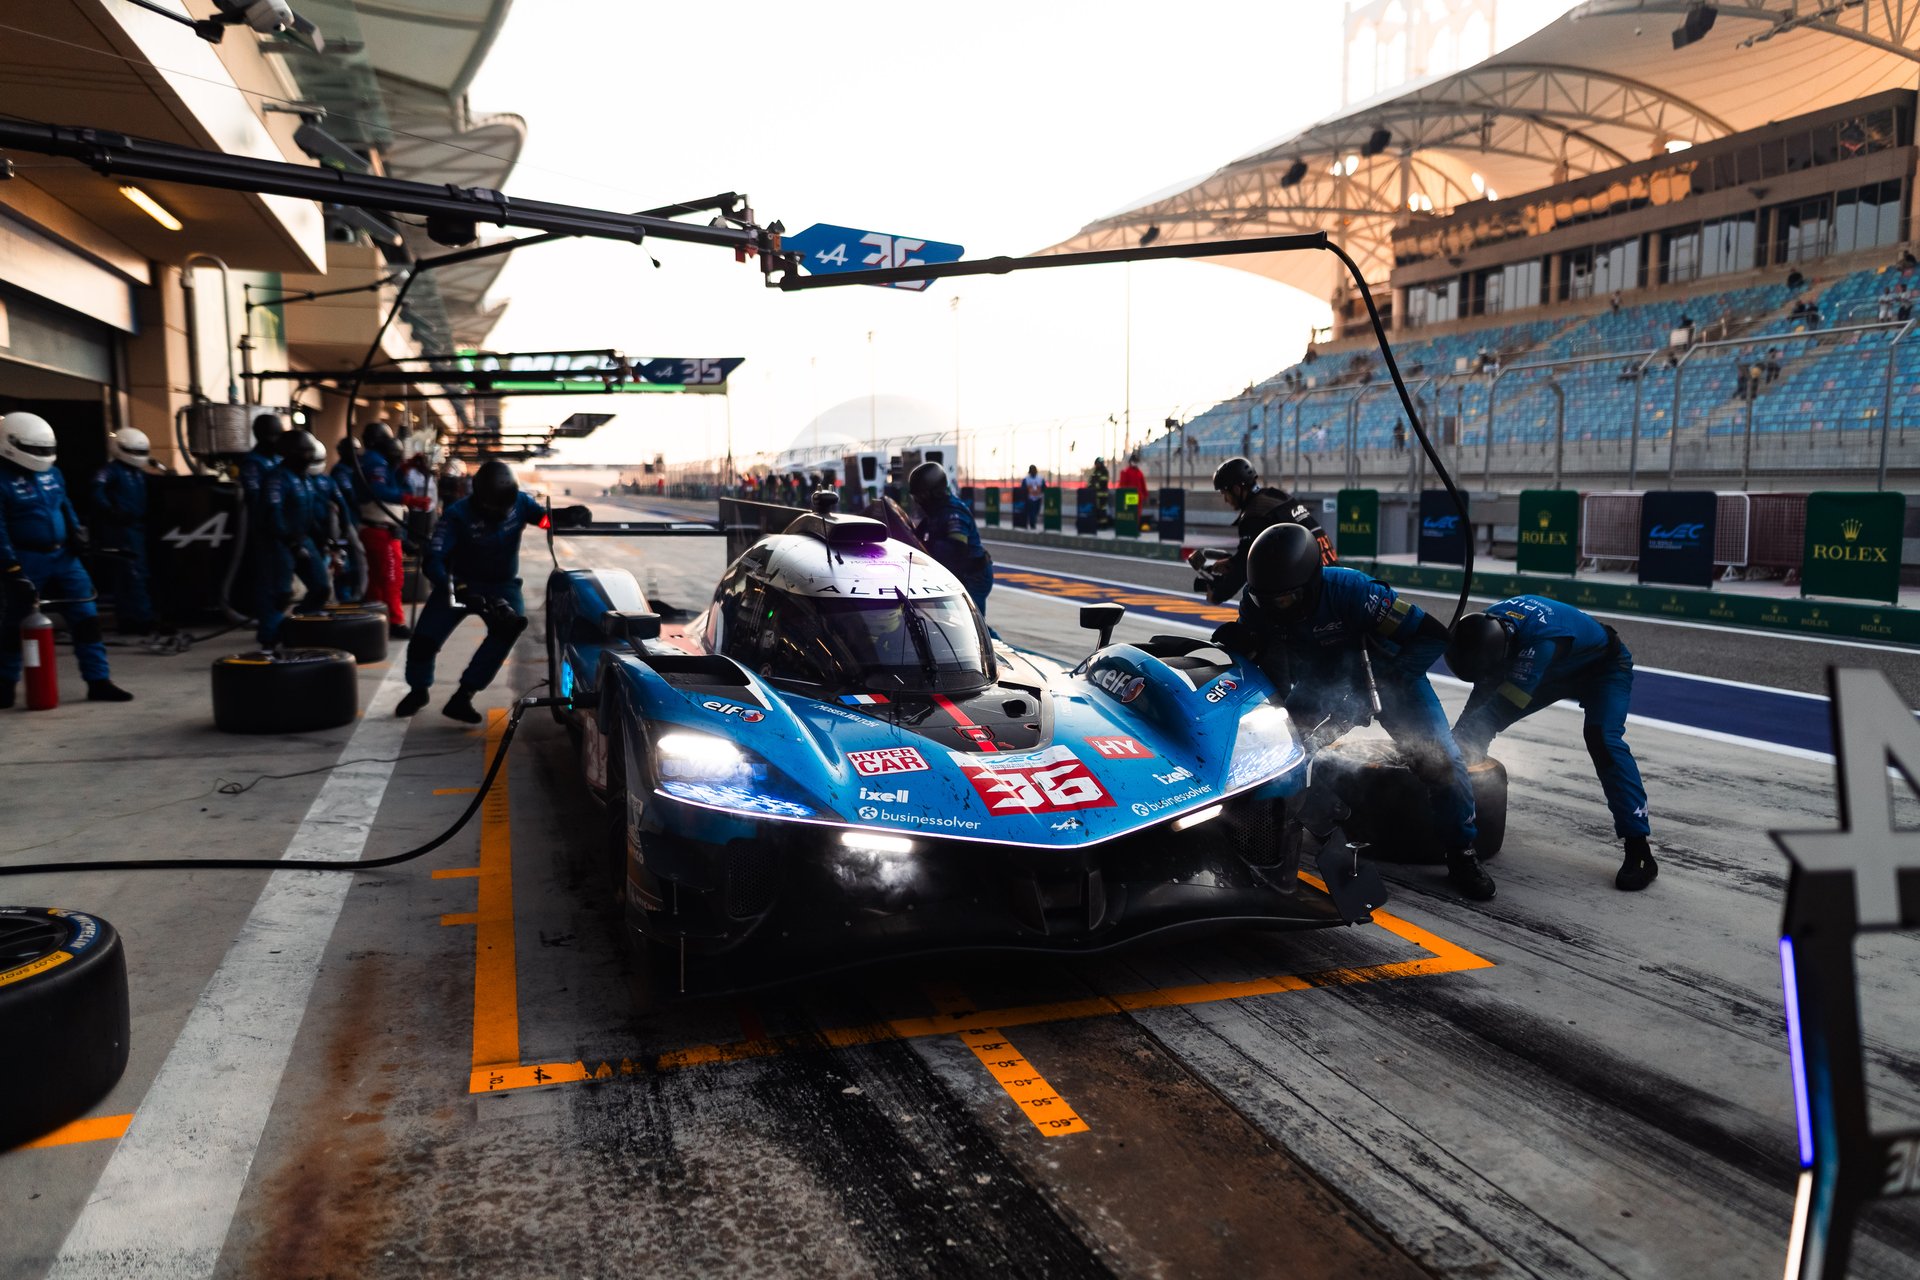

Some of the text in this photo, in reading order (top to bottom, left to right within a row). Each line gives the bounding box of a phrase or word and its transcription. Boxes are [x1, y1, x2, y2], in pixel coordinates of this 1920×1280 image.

[681, 358, 722, 385] 35
[1340, 522, 1371, 534] ROLEX
[1650, 523, 1704, 540] WEC
[1521, 531, 1568, 545] ROLEX
[1813, 544, 1888, 562] ROLEX
[1861, 624, 1892, 635] ROLEX
[1102, 669, 1131, 695] elf
[1205, 683, 1228, 704] elf
[702, 701, 743, 715] elf
[852, 747, 917, 762] HYPER
[1092, 740, 1139, 755] HY
[858, 754, 923, 773] CAR
[1152, 766, 1194, 785] ixell
[972, 763, 1104, 809] 36
[859, 787, 909, 803] ixell
[1145, 784, 1213, 811] businessolver
[881, 809, 982, 831] businessolver
[34, 954, 62, 969] PILOT
[982, 1042, 1003, 1051] 20
[998, 1059, 1018, 1068] 30
[1014, 1079, 1032, 1087] 40
[1031, 1097, 1052, 1107] 50
[1049, 1118, 1071, 1128] 60
